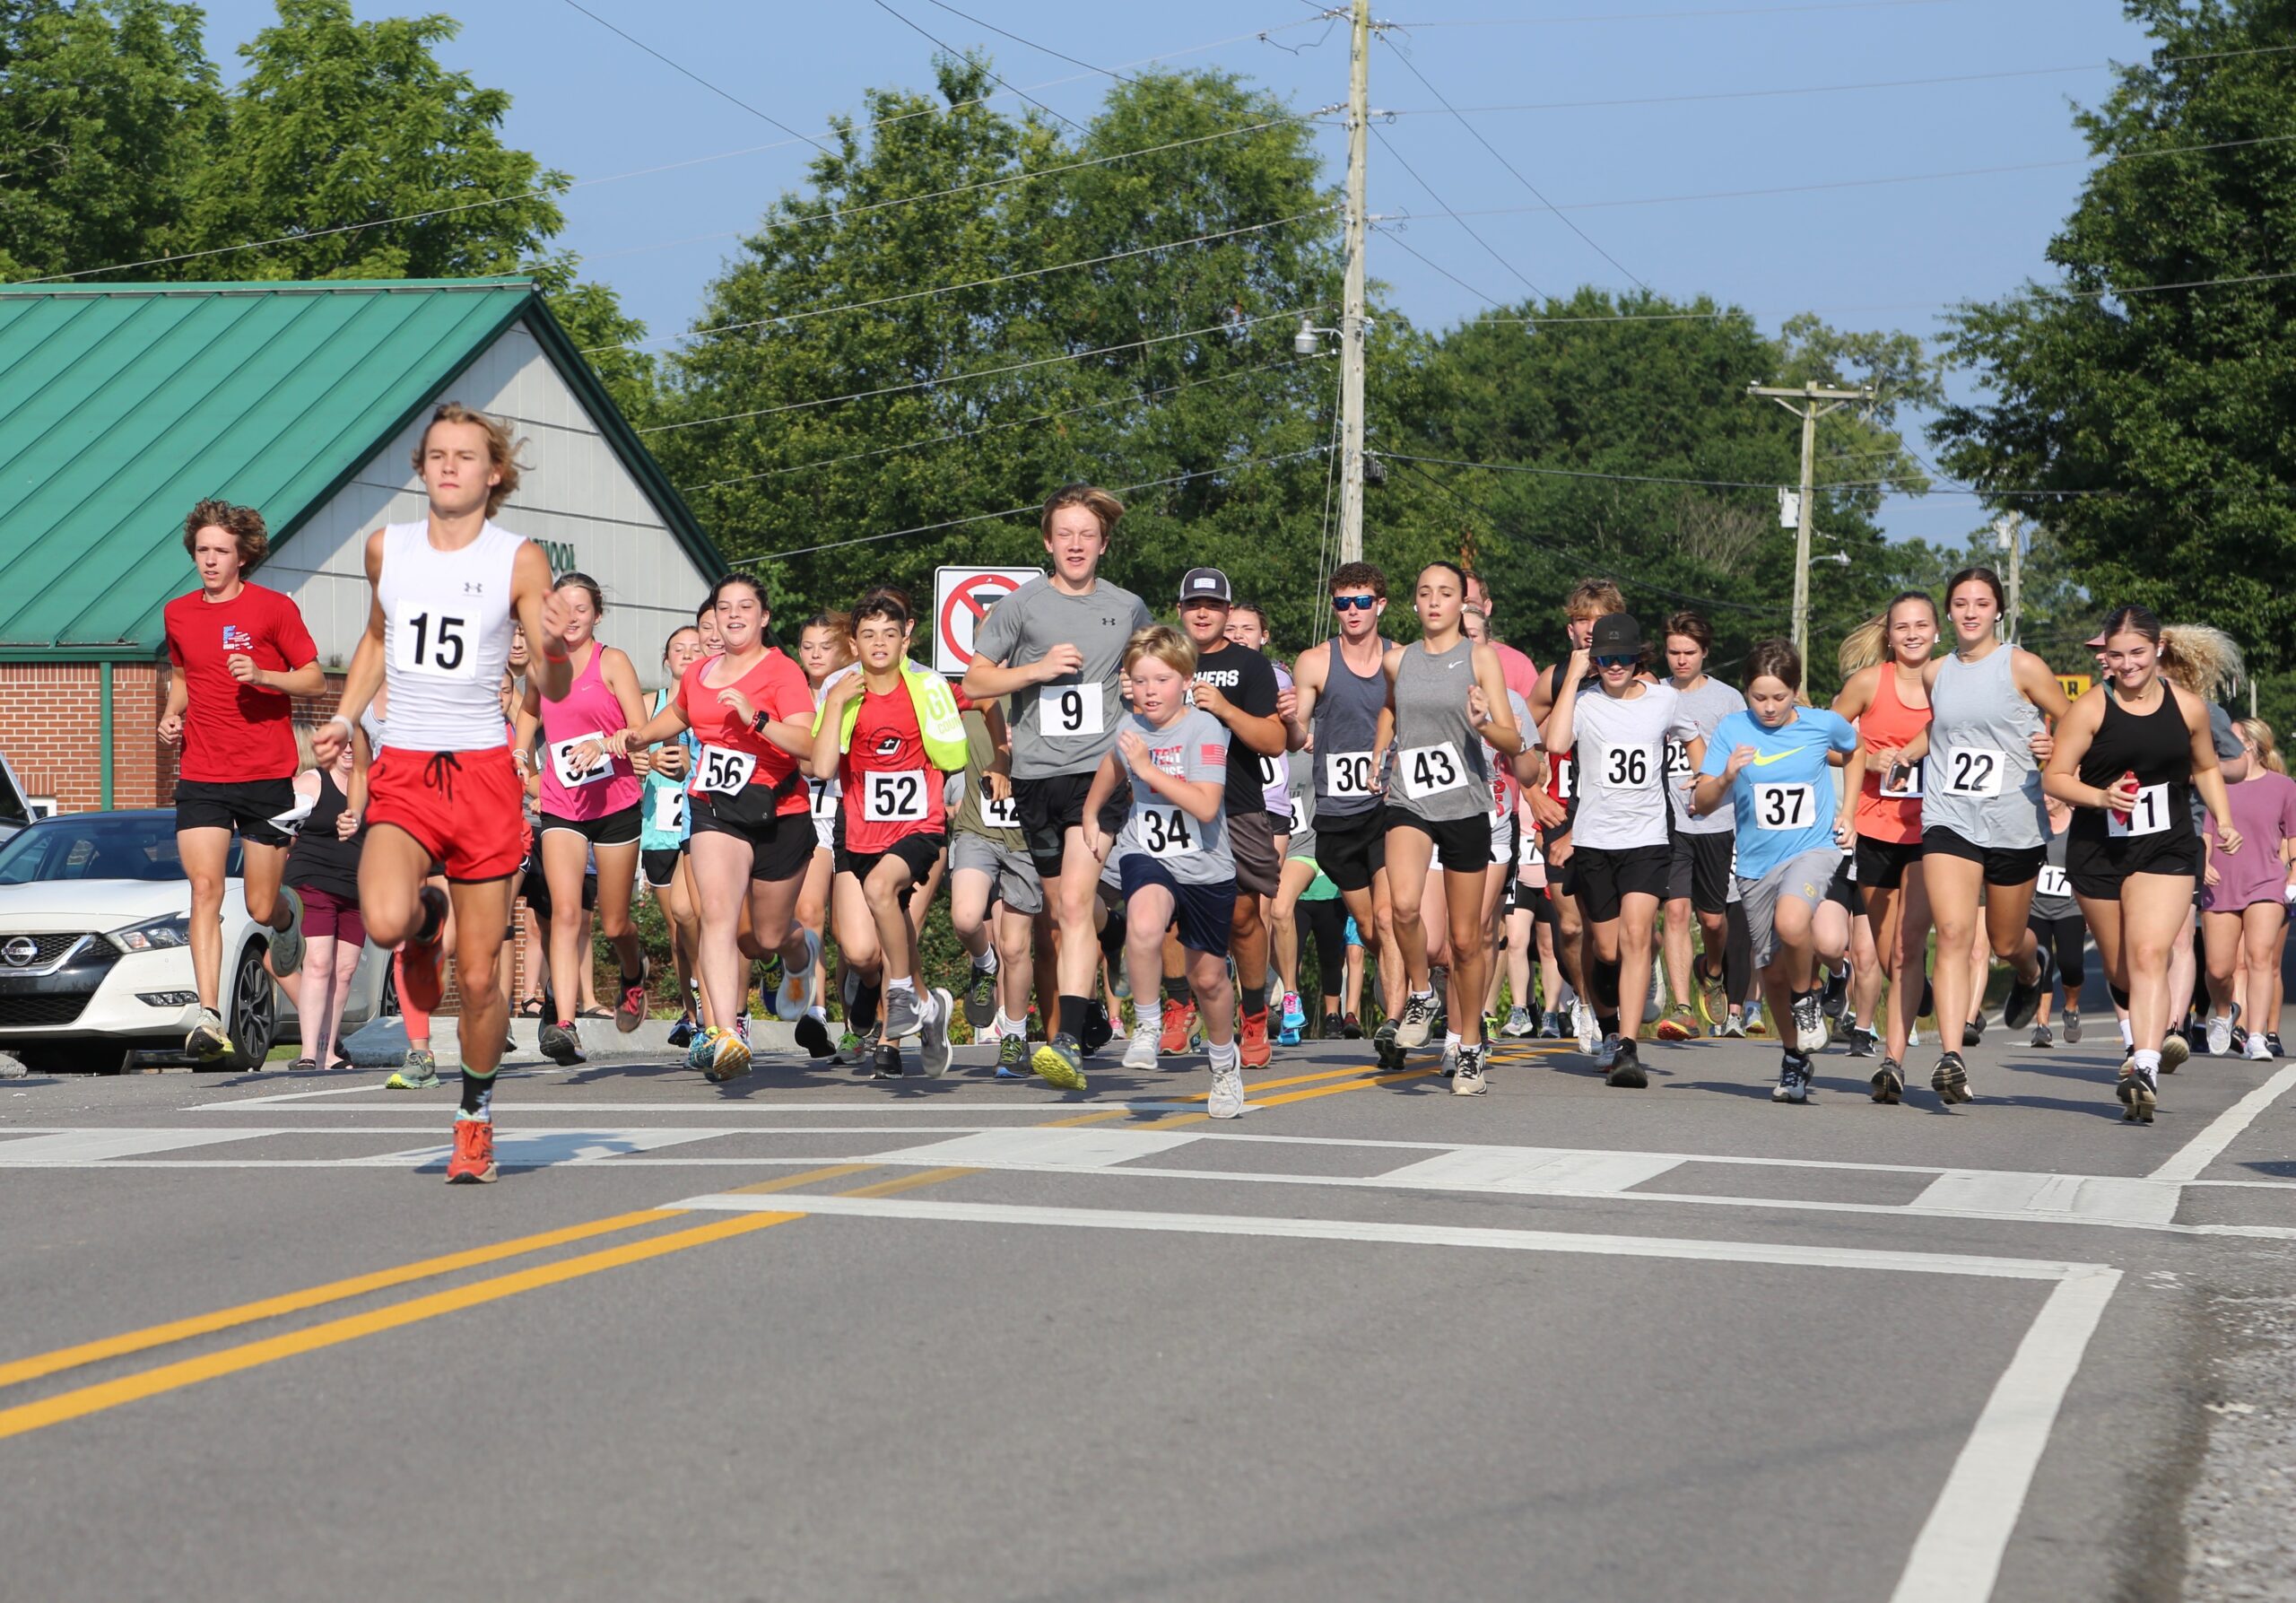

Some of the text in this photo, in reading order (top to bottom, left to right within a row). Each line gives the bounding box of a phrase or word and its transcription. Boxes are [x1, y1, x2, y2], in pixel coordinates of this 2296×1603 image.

[409, 612, 465, 670] 15
[1061, 690, 1083, 730] 9
[561, 745, 604, 782] 3
[705, 752, 744, 788] 56
[1336, 756, 1371, 792] 30
[1413, 750, 1456, 789] 43
[1608, 748, 1646, 784] 36
[1667, 745, 1692, 772] 25
[1954, 752, 1994, 792] 22
[874, 777, 918, 816] 52
[1765, 788, 1805, 825] 37
[1144, 809, 1191, 852] 34
[2046, 871, 2066, 893] 17
